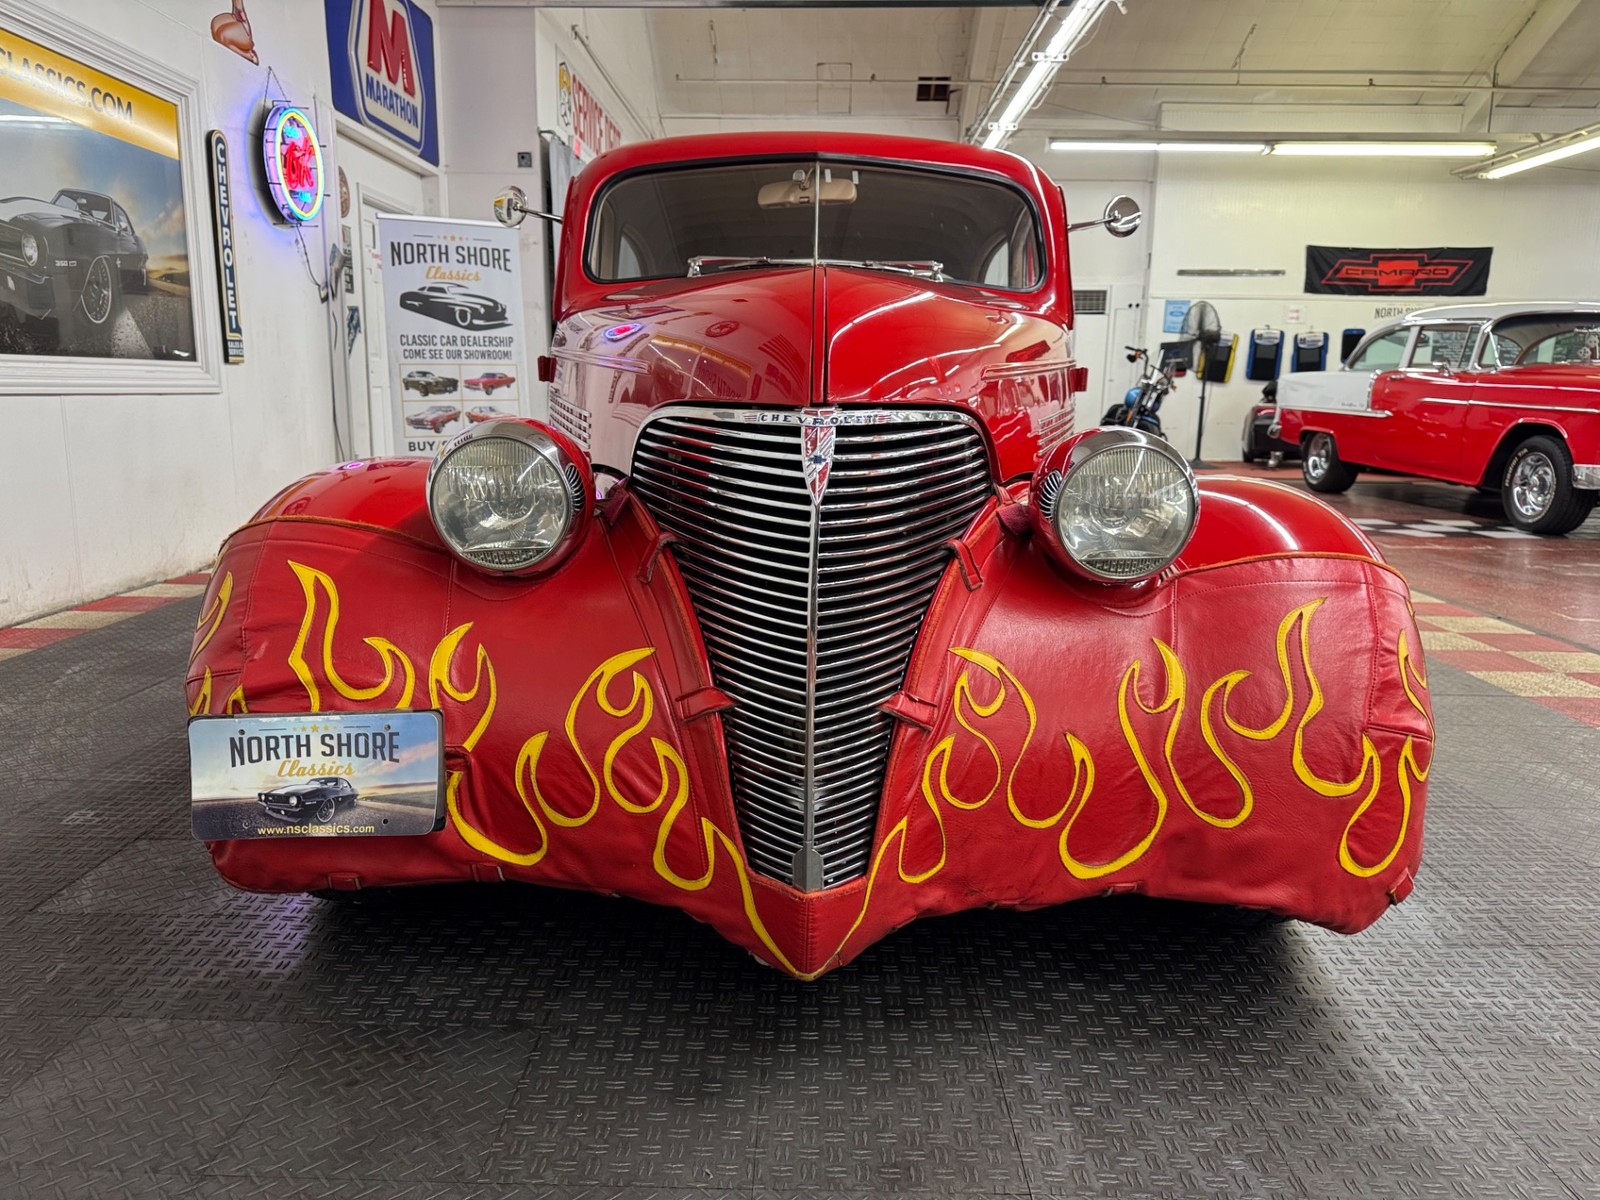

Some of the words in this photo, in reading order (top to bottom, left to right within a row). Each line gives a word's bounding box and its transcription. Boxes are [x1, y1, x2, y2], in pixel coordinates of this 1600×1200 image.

[365, 73, 419, 129] MARATHON
[572, 74, 603, 156] SERVICE
[215, 142, 238, 330] CHEVROLET
[390, 241, 450, 267] NORTH
[455, 245, 512, 273] SHORE
[425, 265, 481, 281] Classics
[1345, 267, 1450, 277] CAMARO
[1374, 306, 1404, 320] NORTH
[400, 334, 438, 346] CLASSIC
[440, 335, 458, 347] CAR
[460, 336, 514, 348] DEALERSHIP
[403, 348, 427, 360] COME
[429, 349, 444, 360] SEE
[446, 349, 463, 360] OUR
[464, 349, 513, 361] SHOWROOM!
[761, 413, 876, 426] CHEVROLET
[408, 441, 436, 452] BUY
[229, 734, 311, 768] NORTH
[320, 731, 400, 763] SHORE
[276, 759, 356, 778] Classics
[256, 823, 375, 836] www.nsclassics.com
